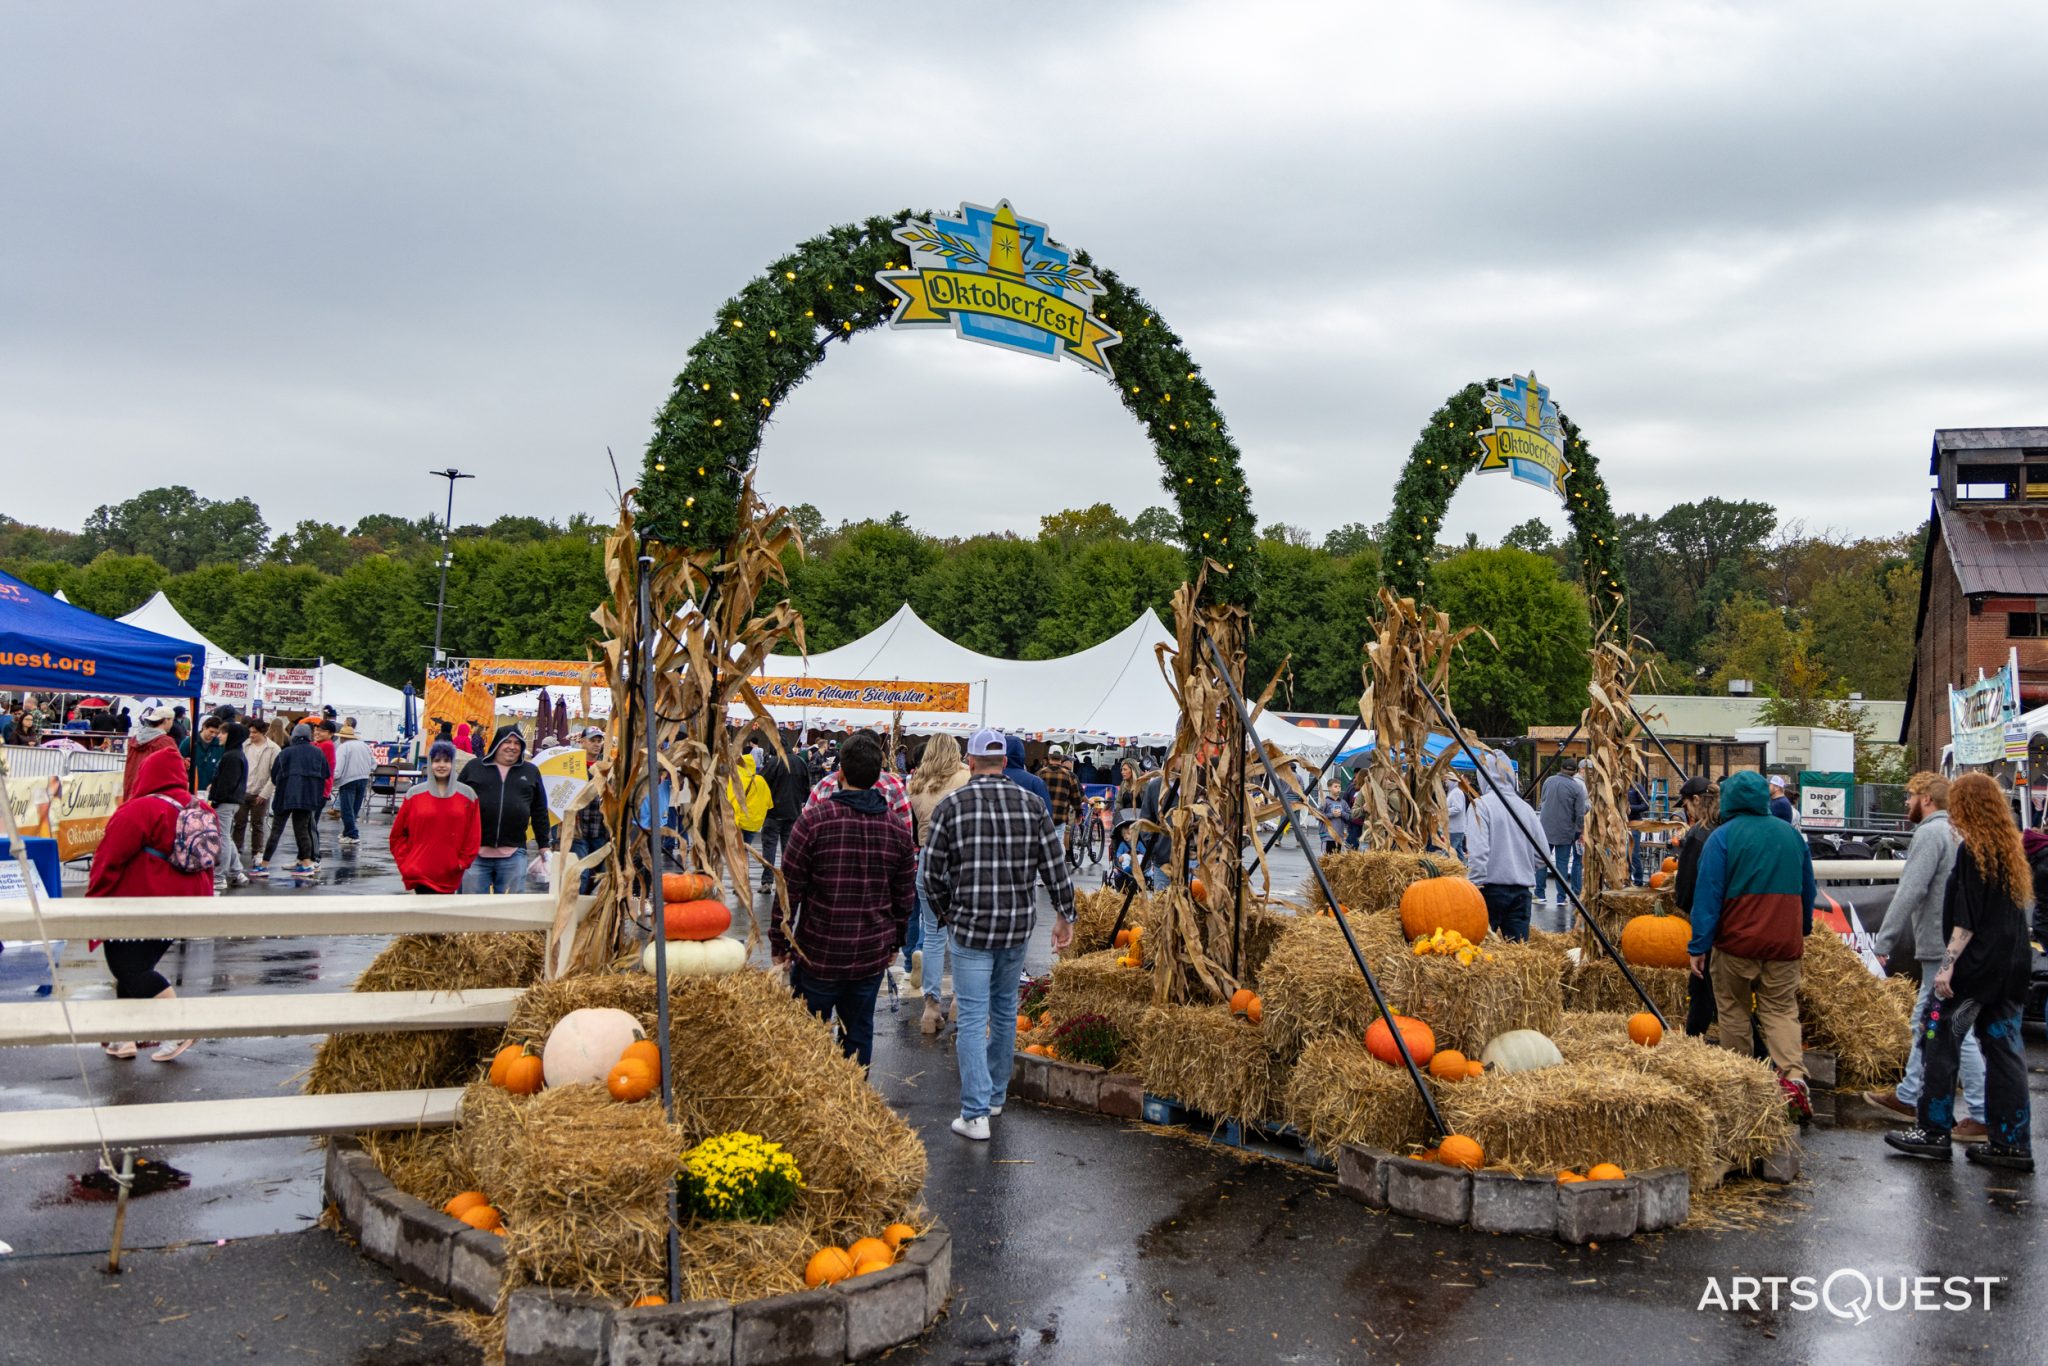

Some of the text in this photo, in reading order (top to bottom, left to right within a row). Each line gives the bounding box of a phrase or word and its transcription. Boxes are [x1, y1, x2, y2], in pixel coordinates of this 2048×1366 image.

[928, 275, 1080, 337] Oktoberfest
[1499, 431, 1560, 472] Oktoberfest
[772, 683, 783, 696] &
[786, 683, 814, 698] Sam
[817, 685, 859, 701] Adams
[862, 685, 926, 704] Biergarten
[1810, 793, 1837, 801] DROP
[1812, 808, 1834, 816] BOX
